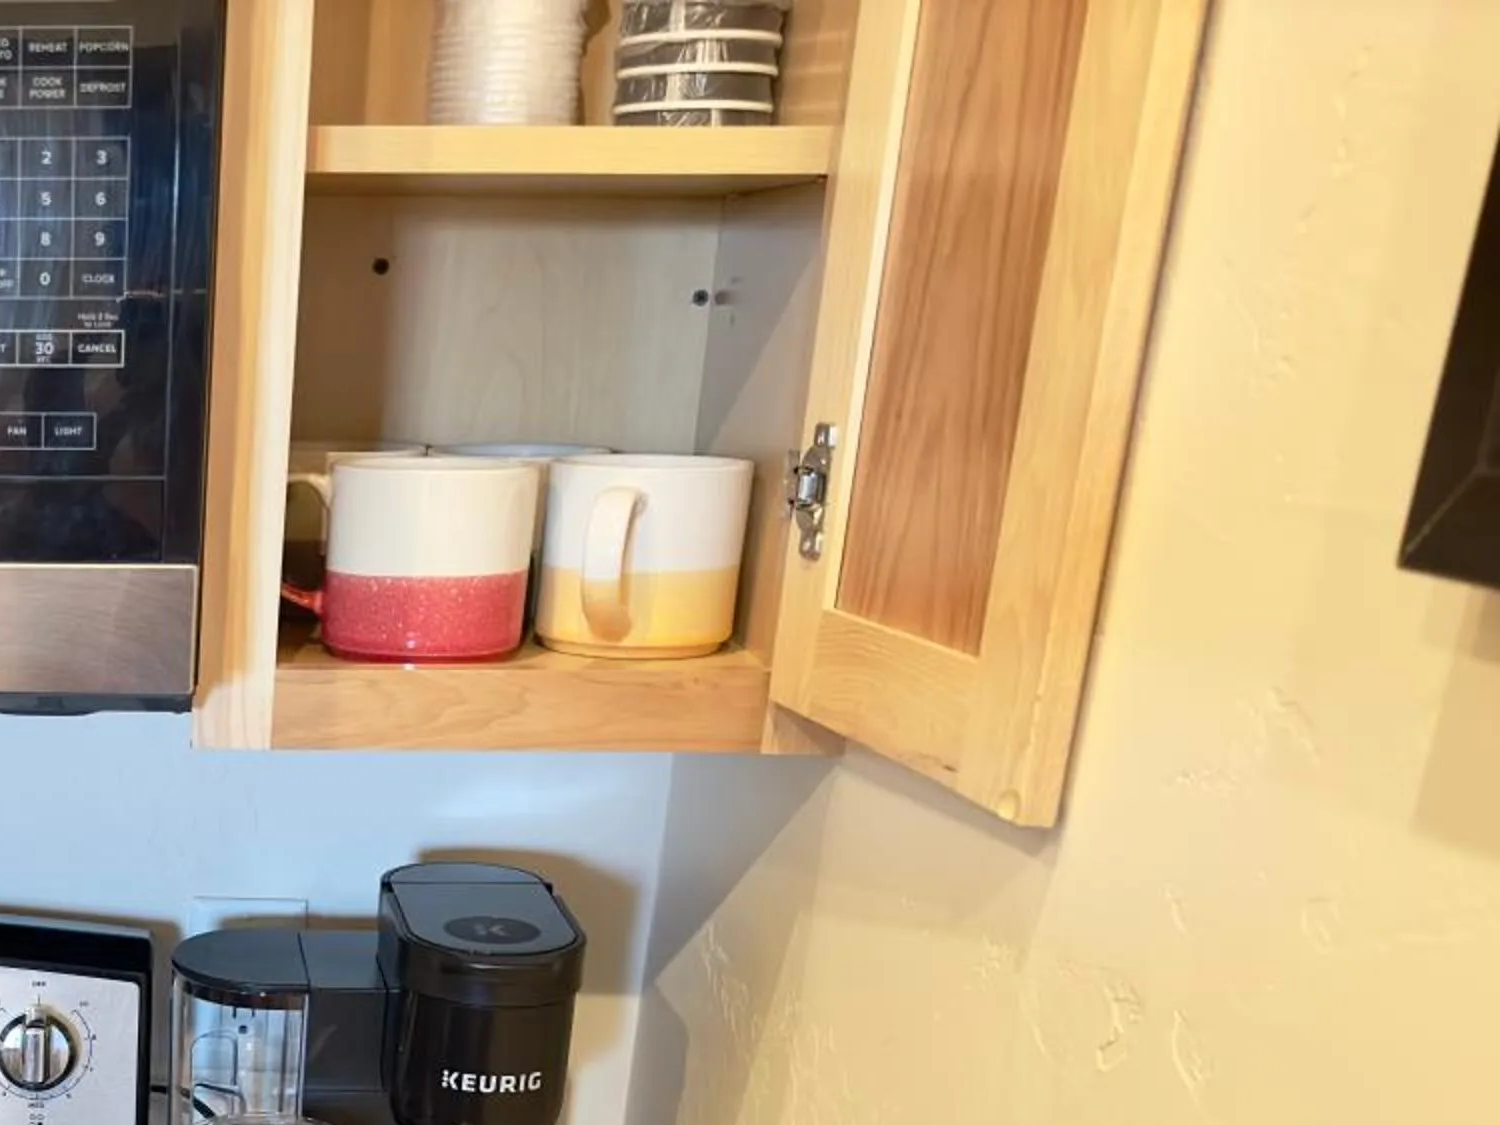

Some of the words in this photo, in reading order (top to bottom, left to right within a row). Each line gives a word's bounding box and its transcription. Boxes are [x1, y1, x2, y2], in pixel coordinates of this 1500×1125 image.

[28, 42, 67, 53] REHEAT
[79, 41, 129, 53] POPCORN
[32, 77, 62, 87] COOK
[79, 82, 127, 93] DEFROST
[29, 88, 66, 99] POWER
[40, 151, 52, 165] 2
[96, 151, 107, 165] 3
[40, 192, 52, 206] 5
[95, 192, 106, 206] 6
[40, 231, 52, 247] 8
[95, 231, 106, 247] 9
[39, 272, 51, 286] 0
[82, 273, 115, 284] CLOCK
[35, 341, 54, 355] 30
[77, 344, 117, 353] CANCEL
[7, 426, 27, 436] FAN
[54, 426, 83, 437] LIGHT
[441, 1069, 543, 1094] KEURIG
